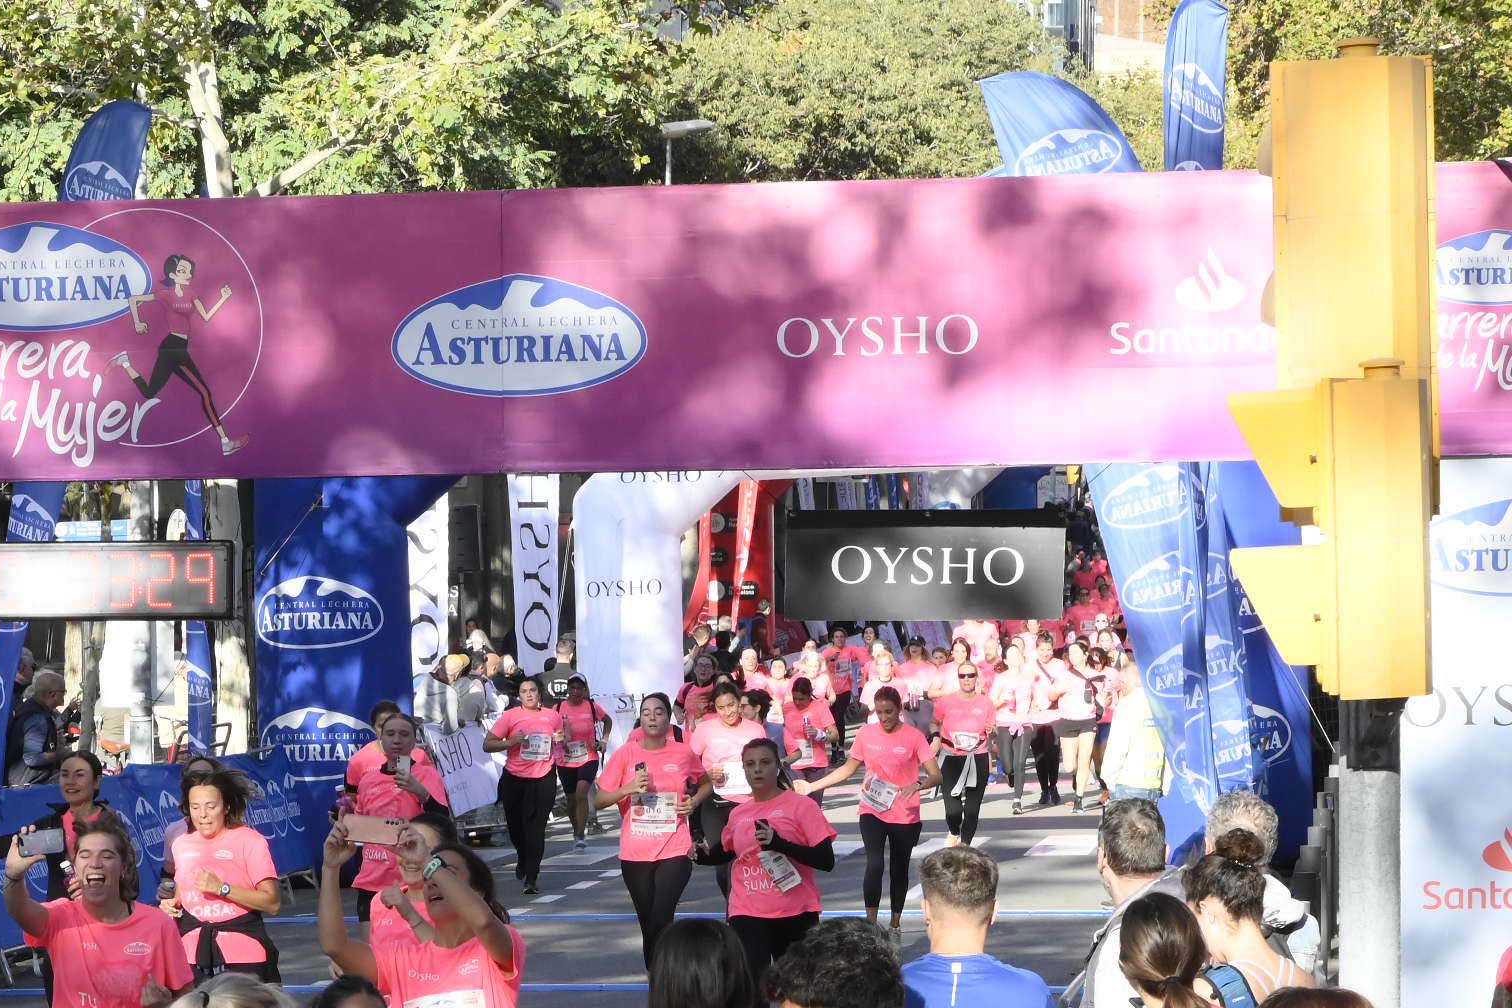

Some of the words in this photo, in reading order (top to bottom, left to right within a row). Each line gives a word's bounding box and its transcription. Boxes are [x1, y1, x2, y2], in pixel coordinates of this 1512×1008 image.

[54, 257, 127, 270] LECHERA
[451, 317, 529, 330] CENTRAL
[538, 315, 618, 328] LECHERA
[412, 322, 627, 366] ASTURIANA
[776, 313, 979, 360] OYSHO
[1109, 321, 1277, 356] Santand
[13, 374, 161, 468] Mujer
[831, 545, 1025, 586] OYSHO
[586, 578, 663, 599] OYSHO
[274, 600, 317, 609] CENTRAL
[321, 600, 370, 609] LECHERA
[261, 606, 375, 633] ASTURIANA
[1405, 683, 1512, 728] OYS
[321, 732, 371, 741] LECHERA
[364, 848, 389, 861] SUMA
[78, 991, 98, 1008] TU
